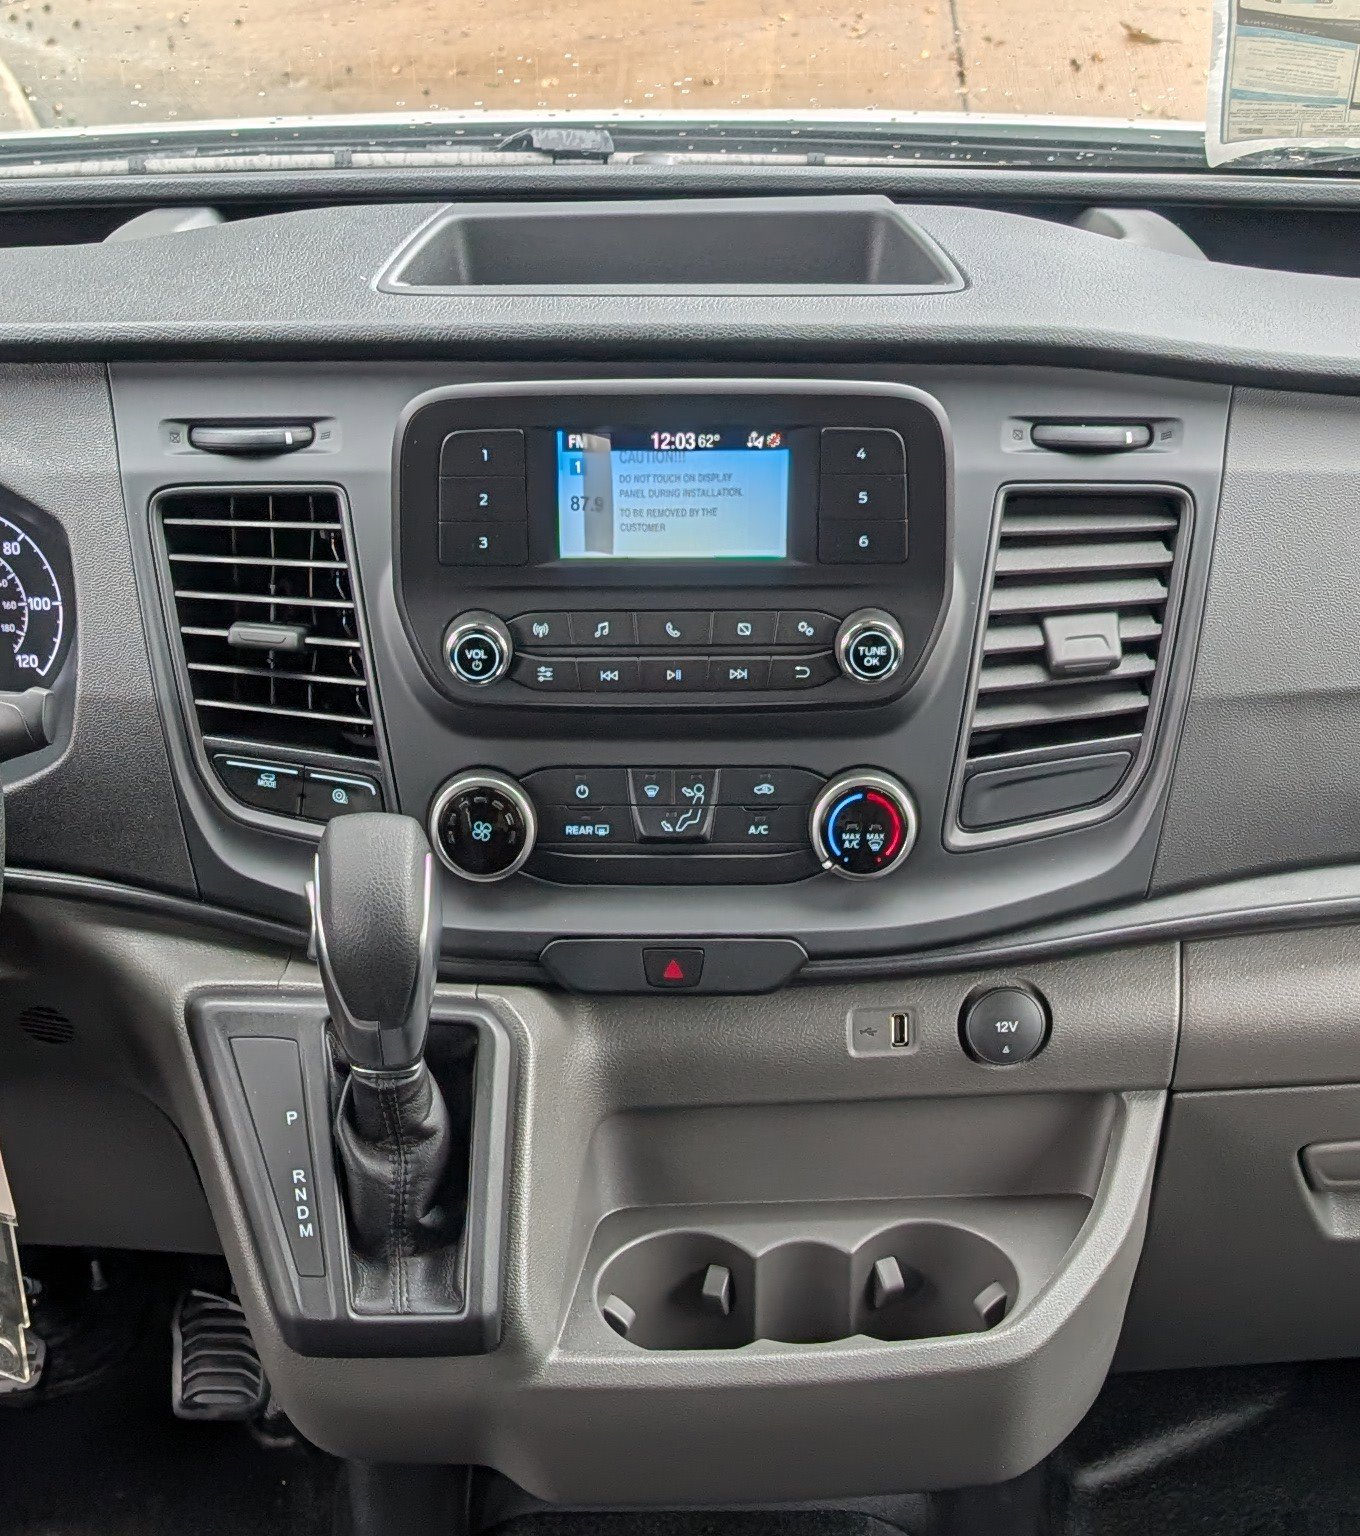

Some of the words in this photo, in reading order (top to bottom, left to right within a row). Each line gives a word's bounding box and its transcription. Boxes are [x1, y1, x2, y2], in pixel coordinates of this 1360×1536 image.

[651, 432, 696, 450] 12:03
[481, 449, 488, 462] 1
[856, 447, 867, 460] 4
[574, 460, 582, 473] 1
[619, 474, 631, 484] DO
[633, 474, 650, 484] NOT
[652, 473, 682, 484] TOUCH
[683, 473, 696, 483] ON
[697, 472, 733, 483] DISPLAY
[619, 489, 646, 499] PANEL
[648, 488, 681, 499] DURING
[858, 491, 869, 504] 5
[479, 494, 489, 506] 2
[619, 508, 631, 518] TO
[633, 508, 644, 518] BE
[646, 508, 687, 518] REMOVED
[689, 507, 700, 517] BY
[701, 507, 718, 517] THE
[620, 523, 666, 533] CUSTOMER
[478, 537, 488, 549] 3
[858, 535, 869, 548] 6
[2, 542, 21, 556] 80
[2, 601, 17, 610] 160
[28, 597, 51, 611] 100
[0, 623, 16, 633] 180
[464, 649, 489, 660] VOL
[857, 646, 888, 657] TUNE
[15, 654, 39, 669] 120
[863, 656, 880, 667] OK
[565, 825, 594, 836] REAR
[748, 824, 769, 836] A/C
[842, 832, 861, 841] MAX
[866, 832, 885, 841] MAX
[843, 840, 860, 849] A/C
[994, 1020, 1019, 1034] 12V
[286, 1110, 298, 1126] P
[292, 1169, 307, 1184] R
[294, 1187, 308, 1202] N
[296, 1205, 309, 1220] D
[299, 1222, 314, 1238] M
